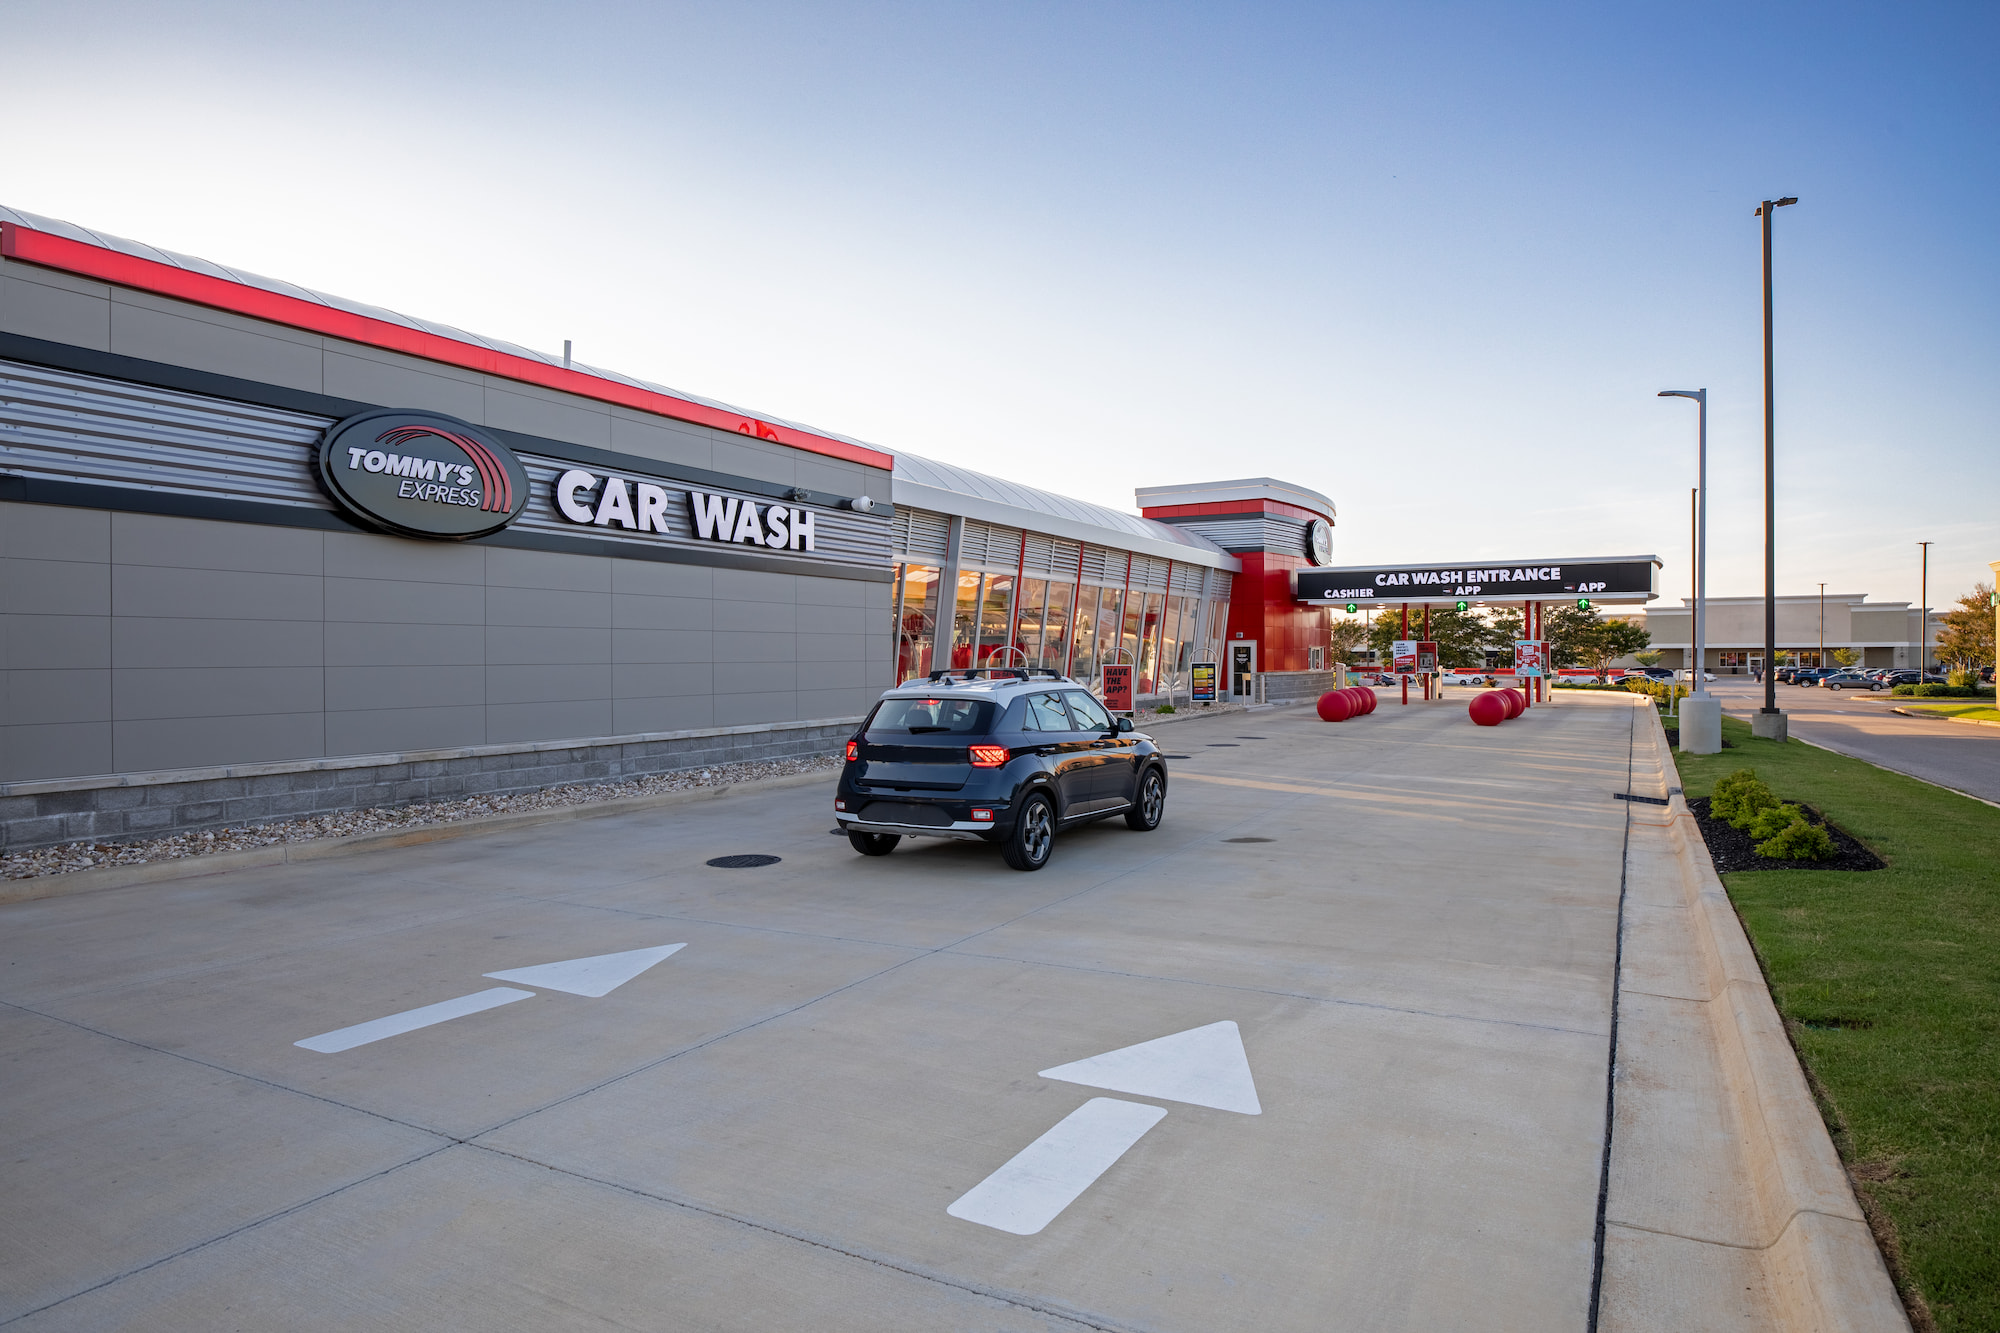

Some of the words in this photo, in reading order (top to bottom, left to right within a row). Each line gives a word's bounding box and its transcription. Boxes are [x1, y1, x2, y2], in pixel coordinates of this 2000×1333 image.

[348, 447, 475, 486] TOMMY'S
[398, 480, 481, 507] EXPRESS
[555, 469, 670, 533] CAR
[690, 491, 815, 552] WASH
[1375, 573, 1410, 586] CAR
[1411, 570, 1463, 585] WASH
[1466, 567, 1561, 583] ENTRANCE
[1454, 585, 1482, 595] APP
[1577, 582, 1607, 592] APP
[1324, 588, 1374, 598] CASHIER
[1106, 668, 1128, 676] HAVE
[1106, 677, 1122, 685] THE
